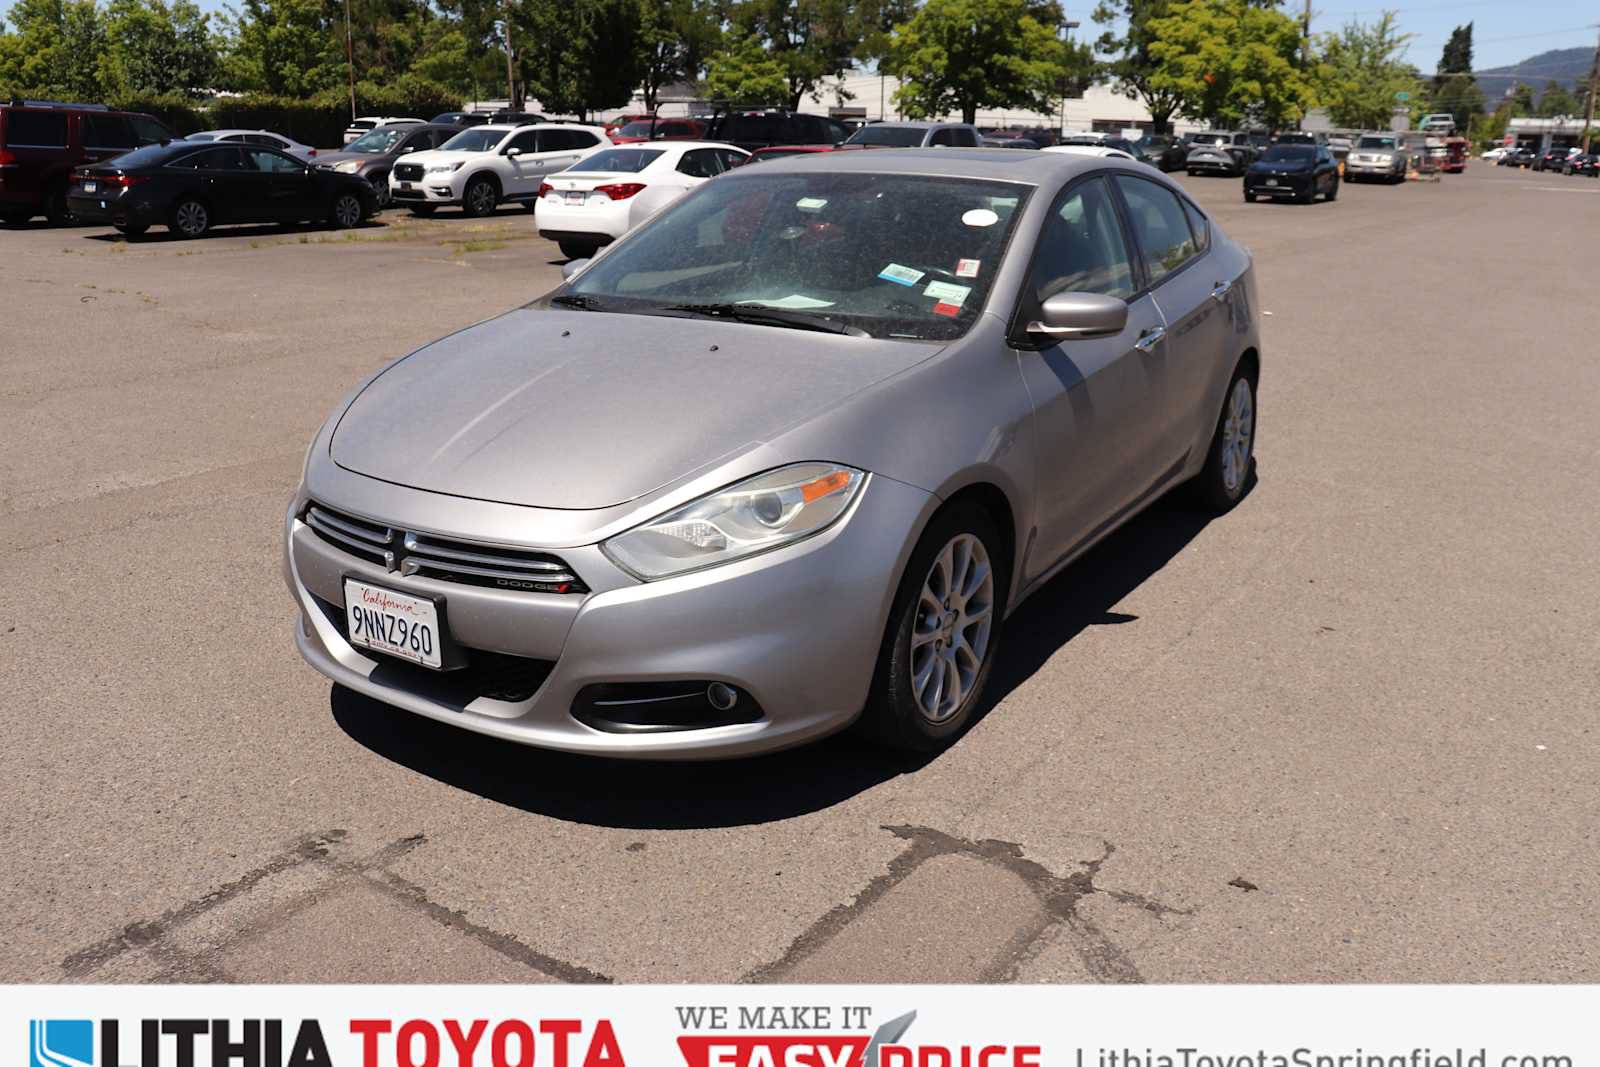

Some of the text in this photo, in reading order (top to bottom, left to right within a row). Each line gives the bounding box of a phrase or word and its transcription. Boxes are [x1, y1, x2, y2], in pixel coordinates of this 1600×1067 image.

[497, 579, 558, 591] DODGE
[363, 588, 415, 613] California
[353, 605, 432, 655] 9NNZ960
